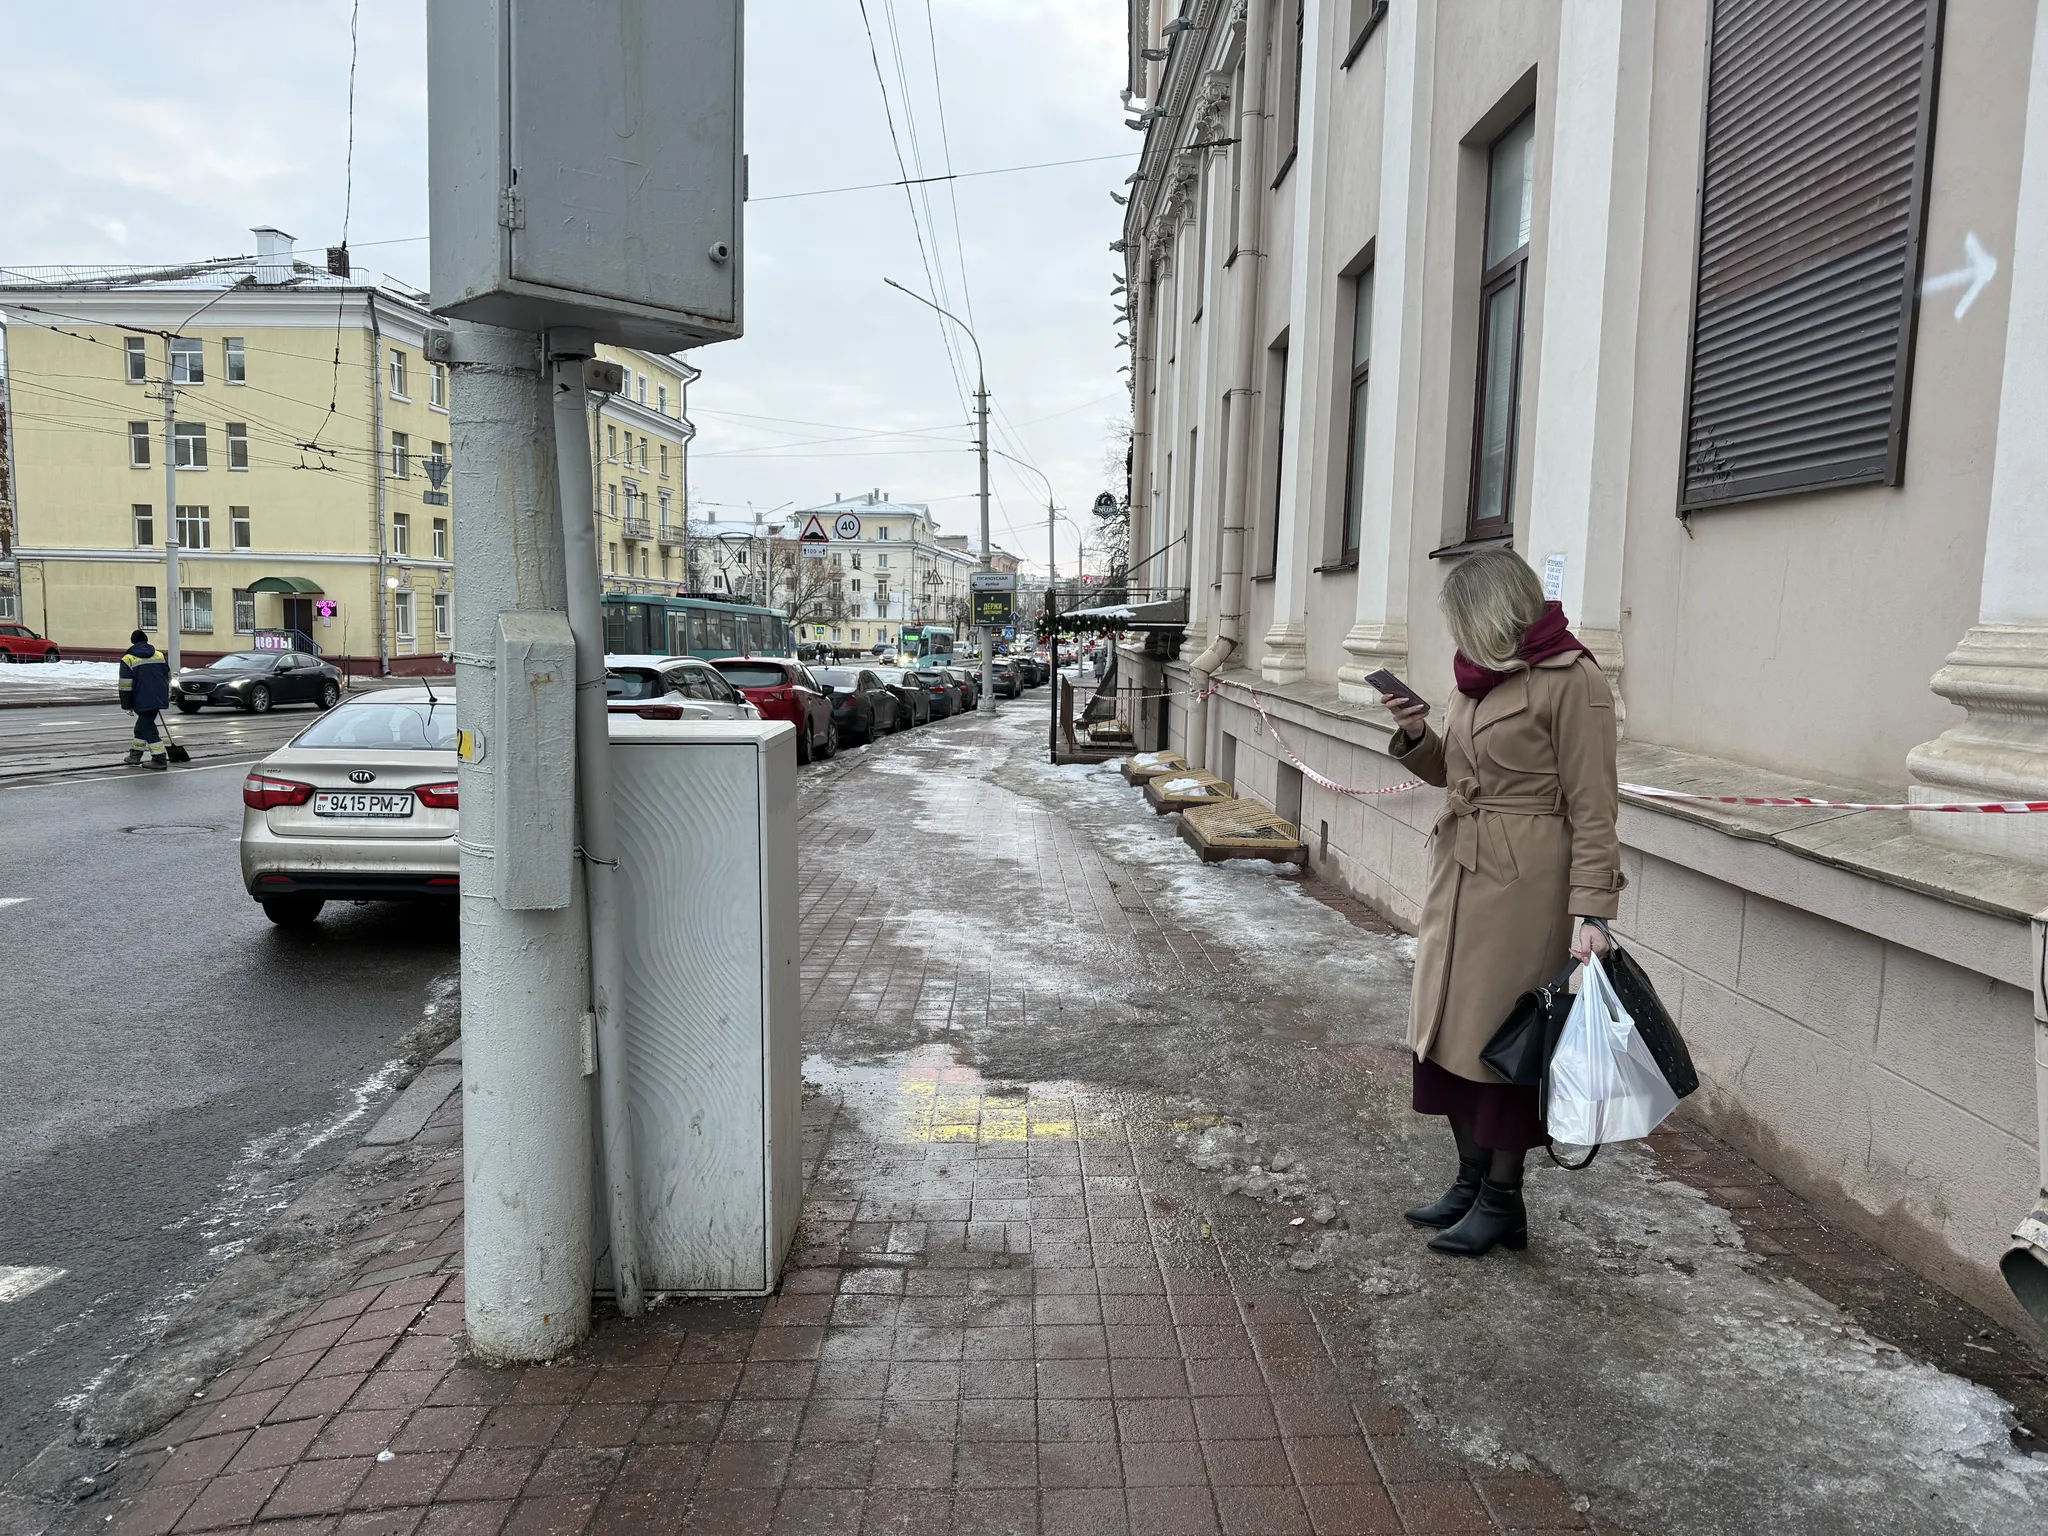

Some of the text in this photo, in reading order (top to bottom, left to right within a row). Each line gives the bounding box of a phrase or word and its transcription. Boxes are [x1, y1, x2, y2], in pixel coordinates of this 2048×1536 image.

[841, 520, 855, 531] 40
[352, 772, 371, 781] KIA
[330, 795, 366, 812] 9415
[369, 796, 409, 812] PM-7
